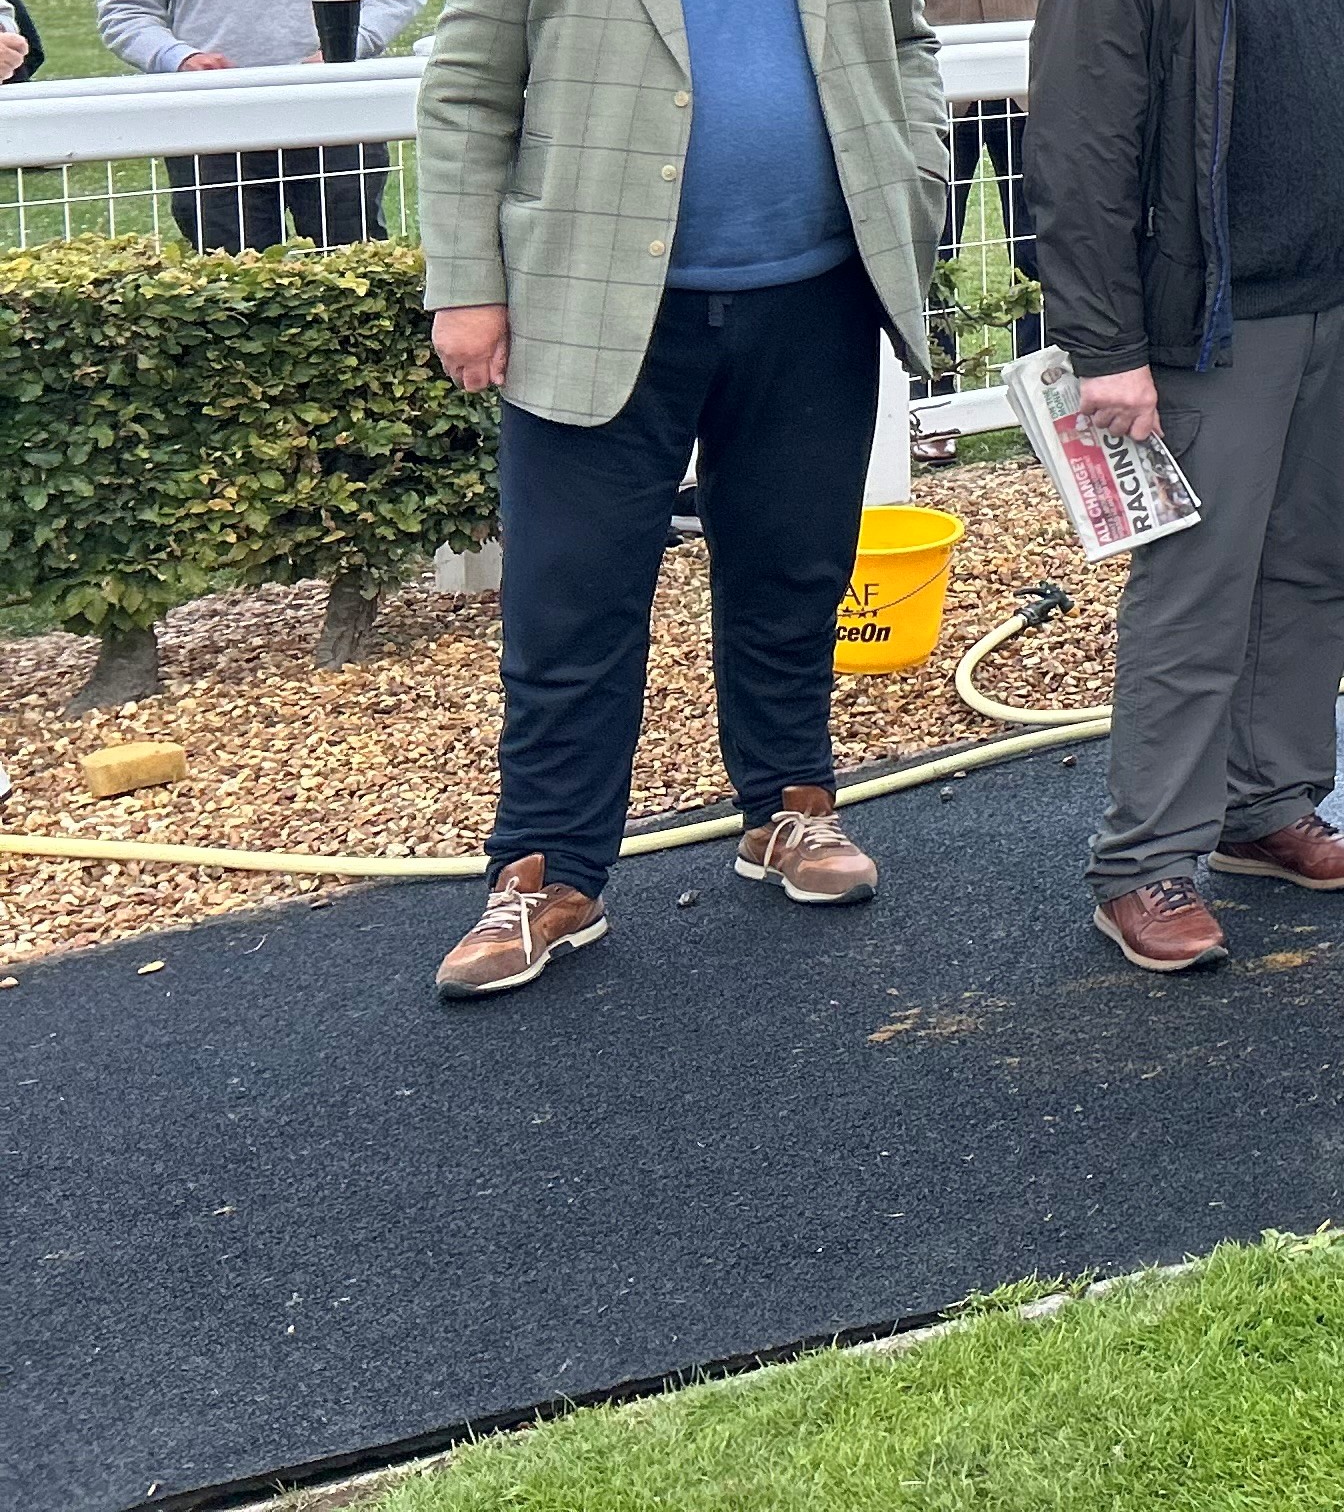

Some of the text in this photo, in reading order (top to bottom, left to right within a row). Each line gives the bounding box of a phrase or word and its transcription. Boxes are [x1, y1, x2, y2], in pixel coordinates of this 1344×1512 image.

[1102, 433, 1152, 534] RACING
[1094, 519, 1112, 542] ALL
[840, 583, 880, 606] AF
[836, 622, 892, 642] ceOn
